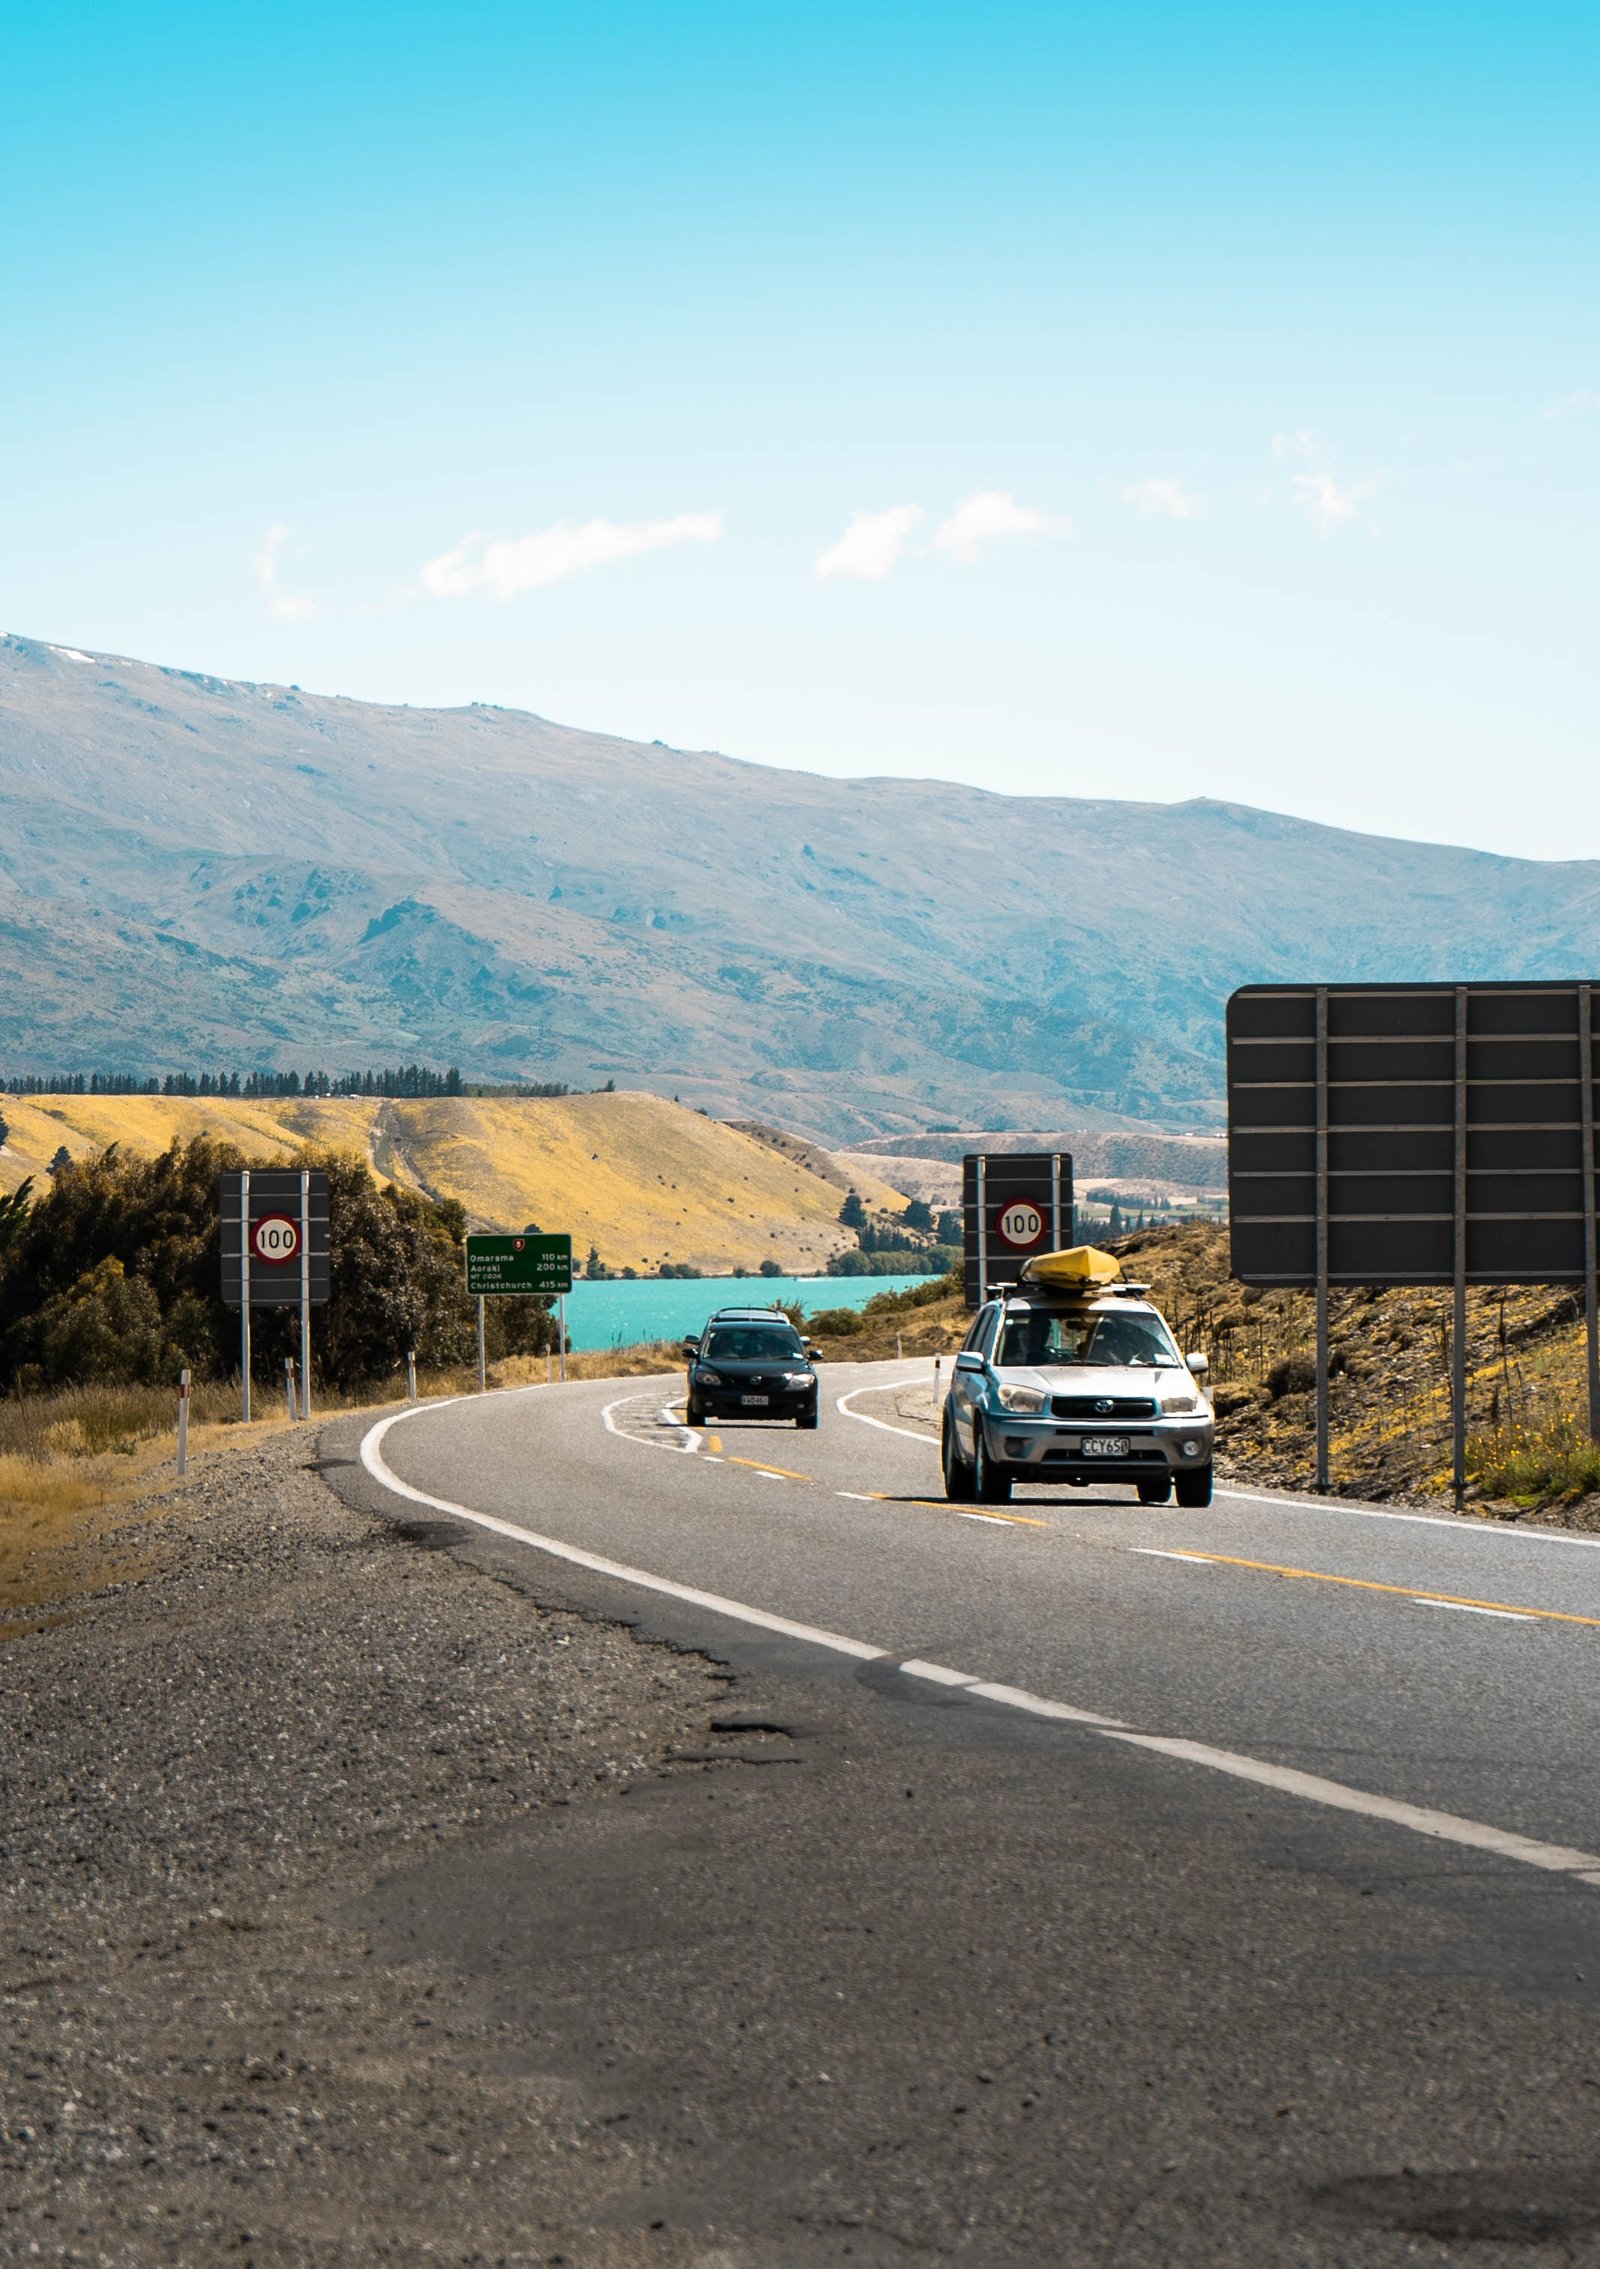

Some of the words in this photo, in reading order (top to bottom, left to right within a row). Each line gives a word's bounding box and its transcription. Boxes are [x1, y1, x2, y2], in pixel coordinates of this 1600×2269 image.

[1005, 1214, 1039, 1234] 100
[260, 1230, 294, 1249] 100
[536, 1263, 555, 1271] 200
[470, 1282, 532, 1290] Christchurch
